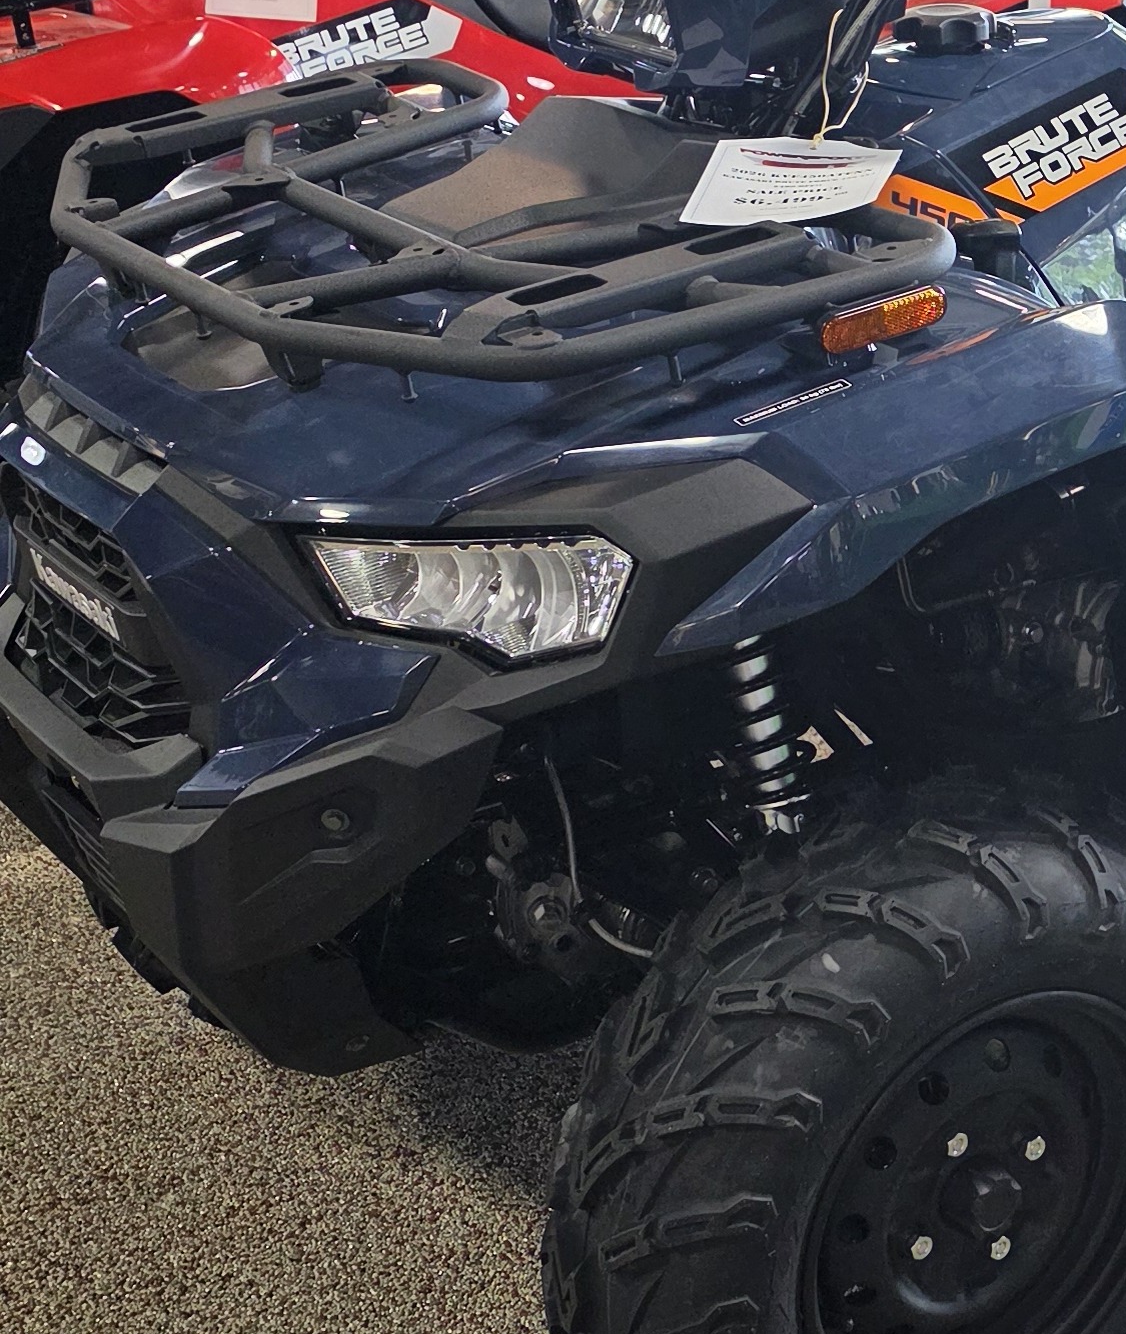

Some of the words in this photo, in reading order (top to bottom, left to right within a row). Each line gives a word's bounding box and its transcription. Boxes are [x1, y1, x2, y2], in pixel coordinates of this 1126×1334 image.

[279, 7, 400, 65] BRUTE
[302, 23, 428, 78] FORCE
[982, 93, 1119, 178] BRUTE
[30, 548, 120, 641] Kawasaki
